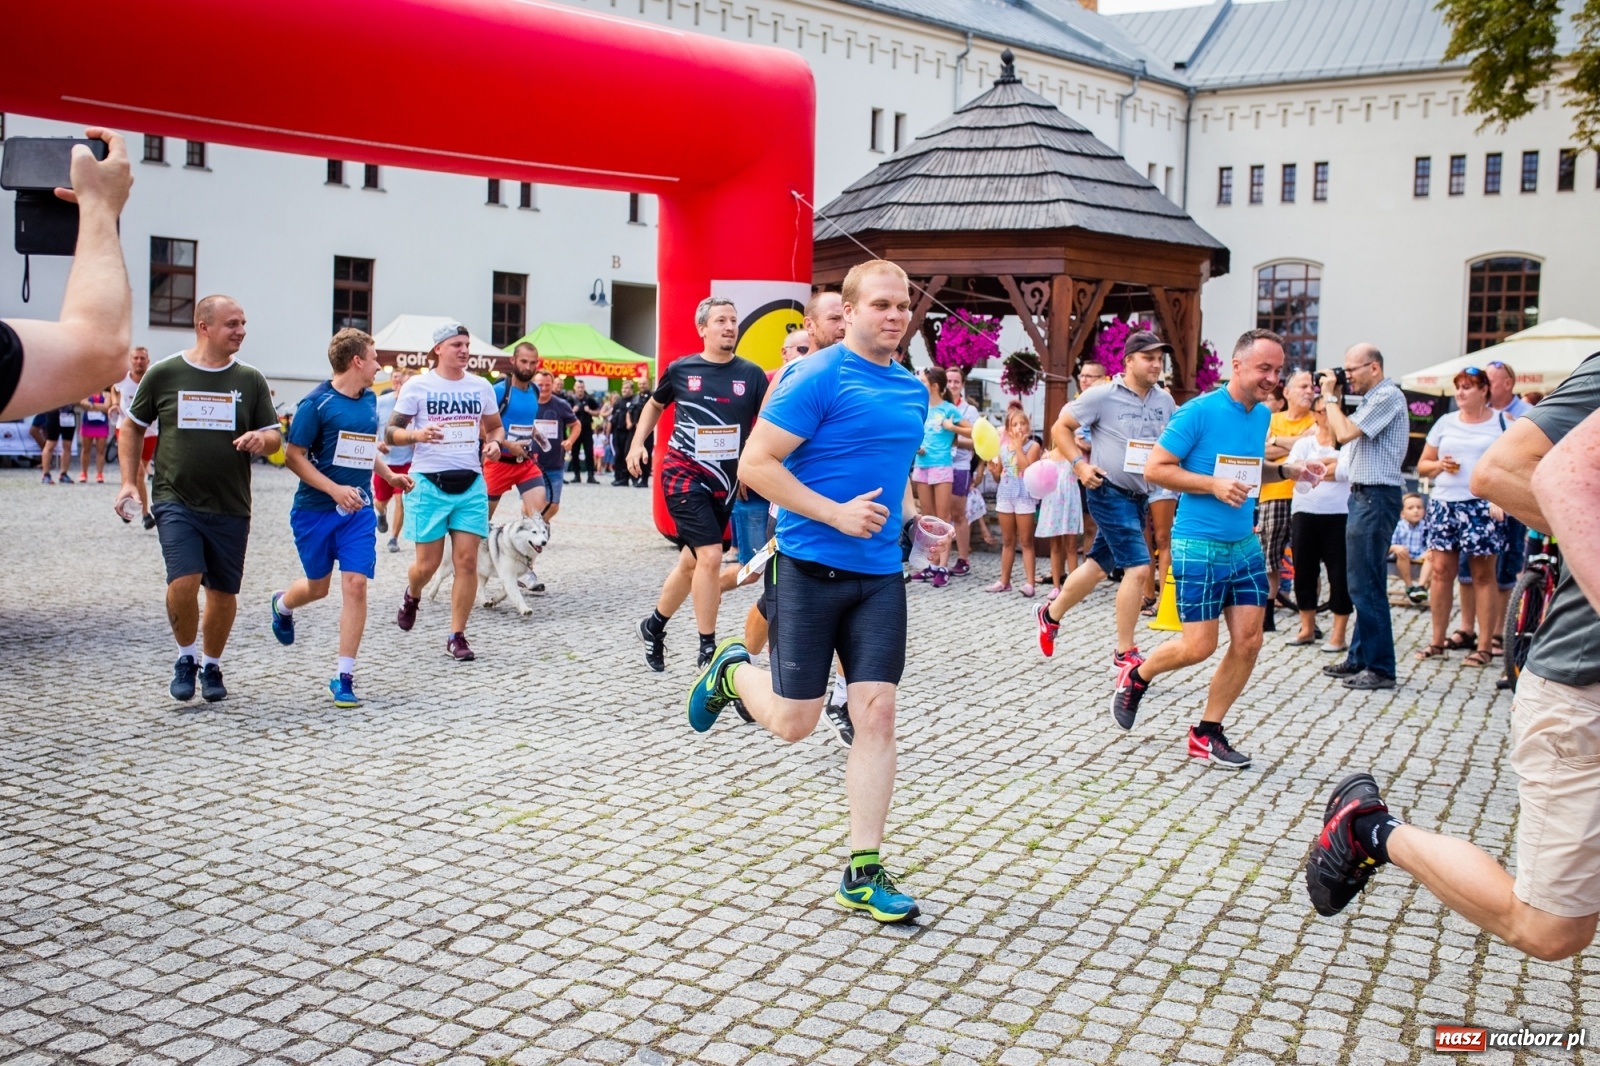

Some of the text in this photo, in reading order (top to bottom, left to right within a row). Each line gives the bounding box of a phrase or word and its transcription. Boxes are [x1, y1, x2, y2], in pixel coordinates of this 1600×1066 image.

[611, 254, 621, 269] B
[464, 355, 497, 372] ofry
[426, 391, 481, 403] HOUSE
[201, 405, 215, 416] 57
[426, 400, 482, 415] BRAND
[451, 430, 463, 440] 59
[713, 438, 726, 448] 58
[354, 444, 365, 455] 60
[1234, 470, 1248, 481] 48
